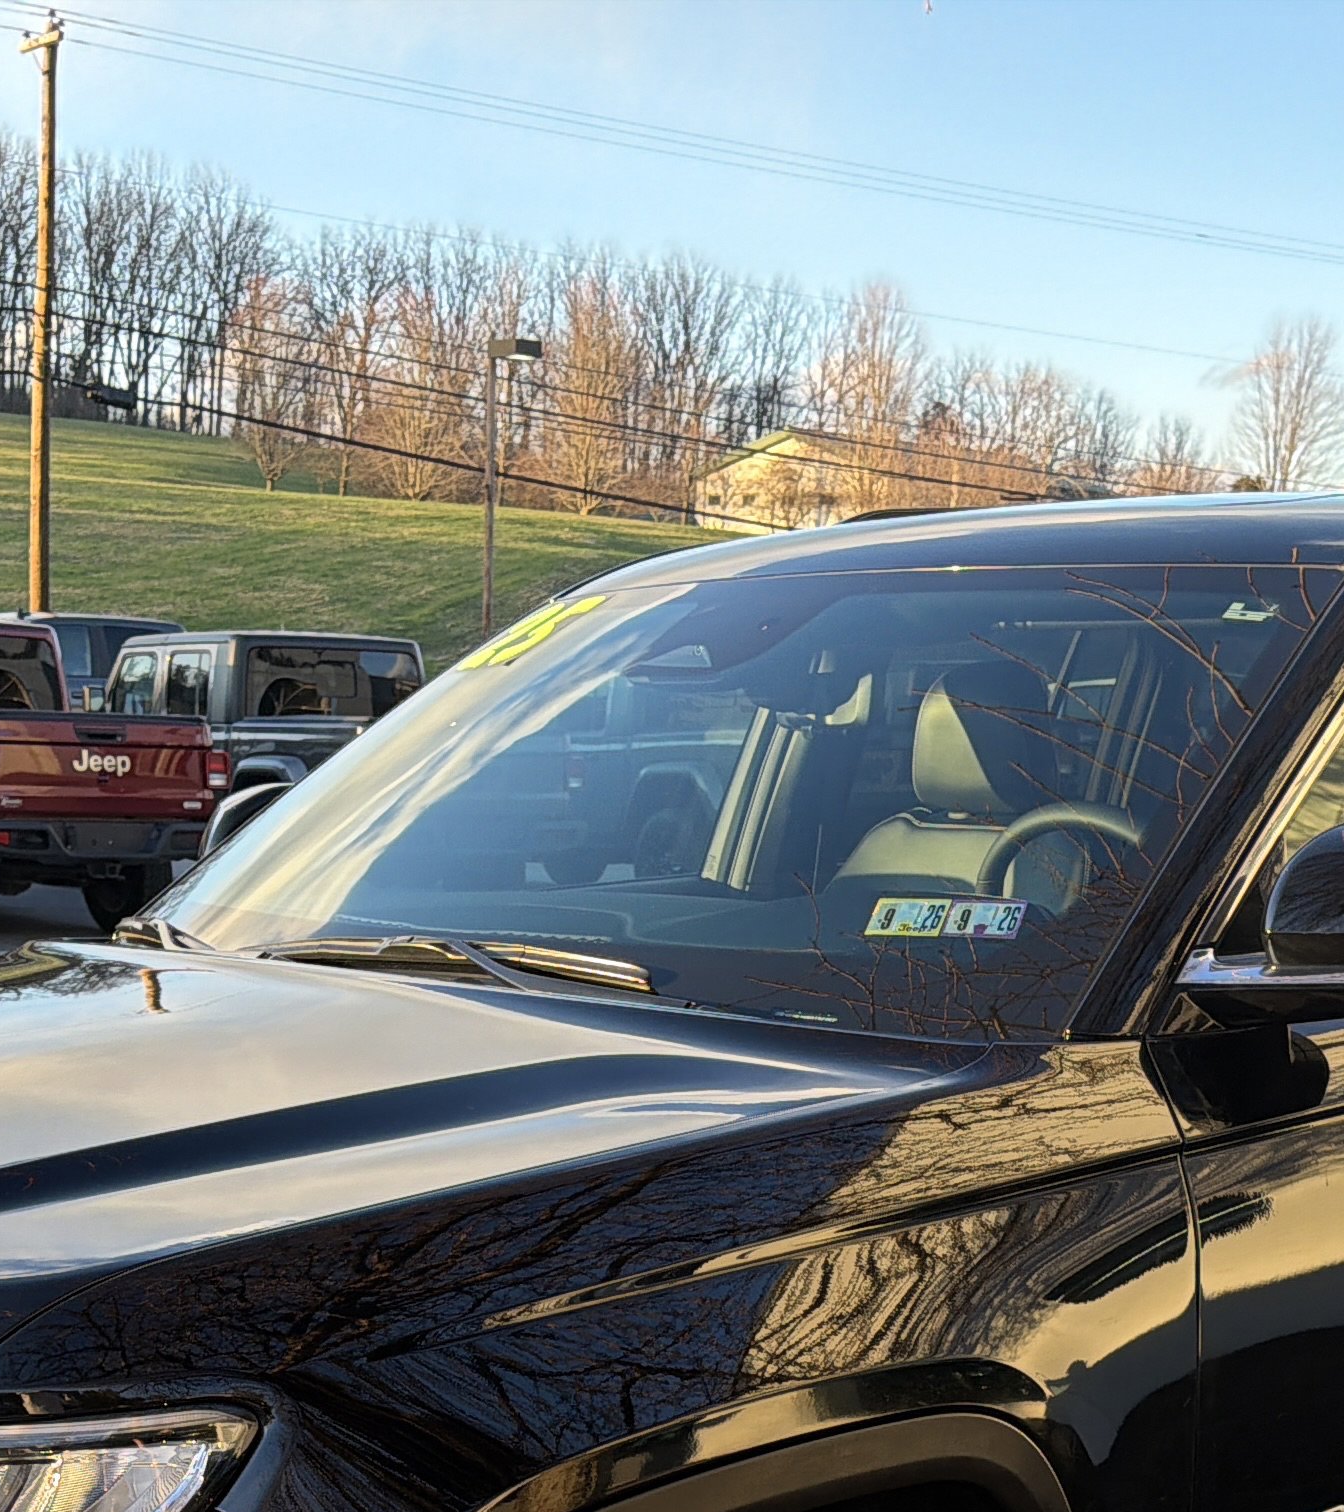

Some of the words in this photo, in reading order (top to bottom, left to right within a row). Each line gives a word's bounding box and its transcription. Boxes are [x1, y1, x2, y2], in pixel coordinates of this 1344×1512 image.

[72, 749, 131, 777] Jeep
[880, 908, 897, 930] 9
[920, 904, 947, 931] 26
[956, 908, 972, 931] 9
[996, 906, 1022, 932] 26
